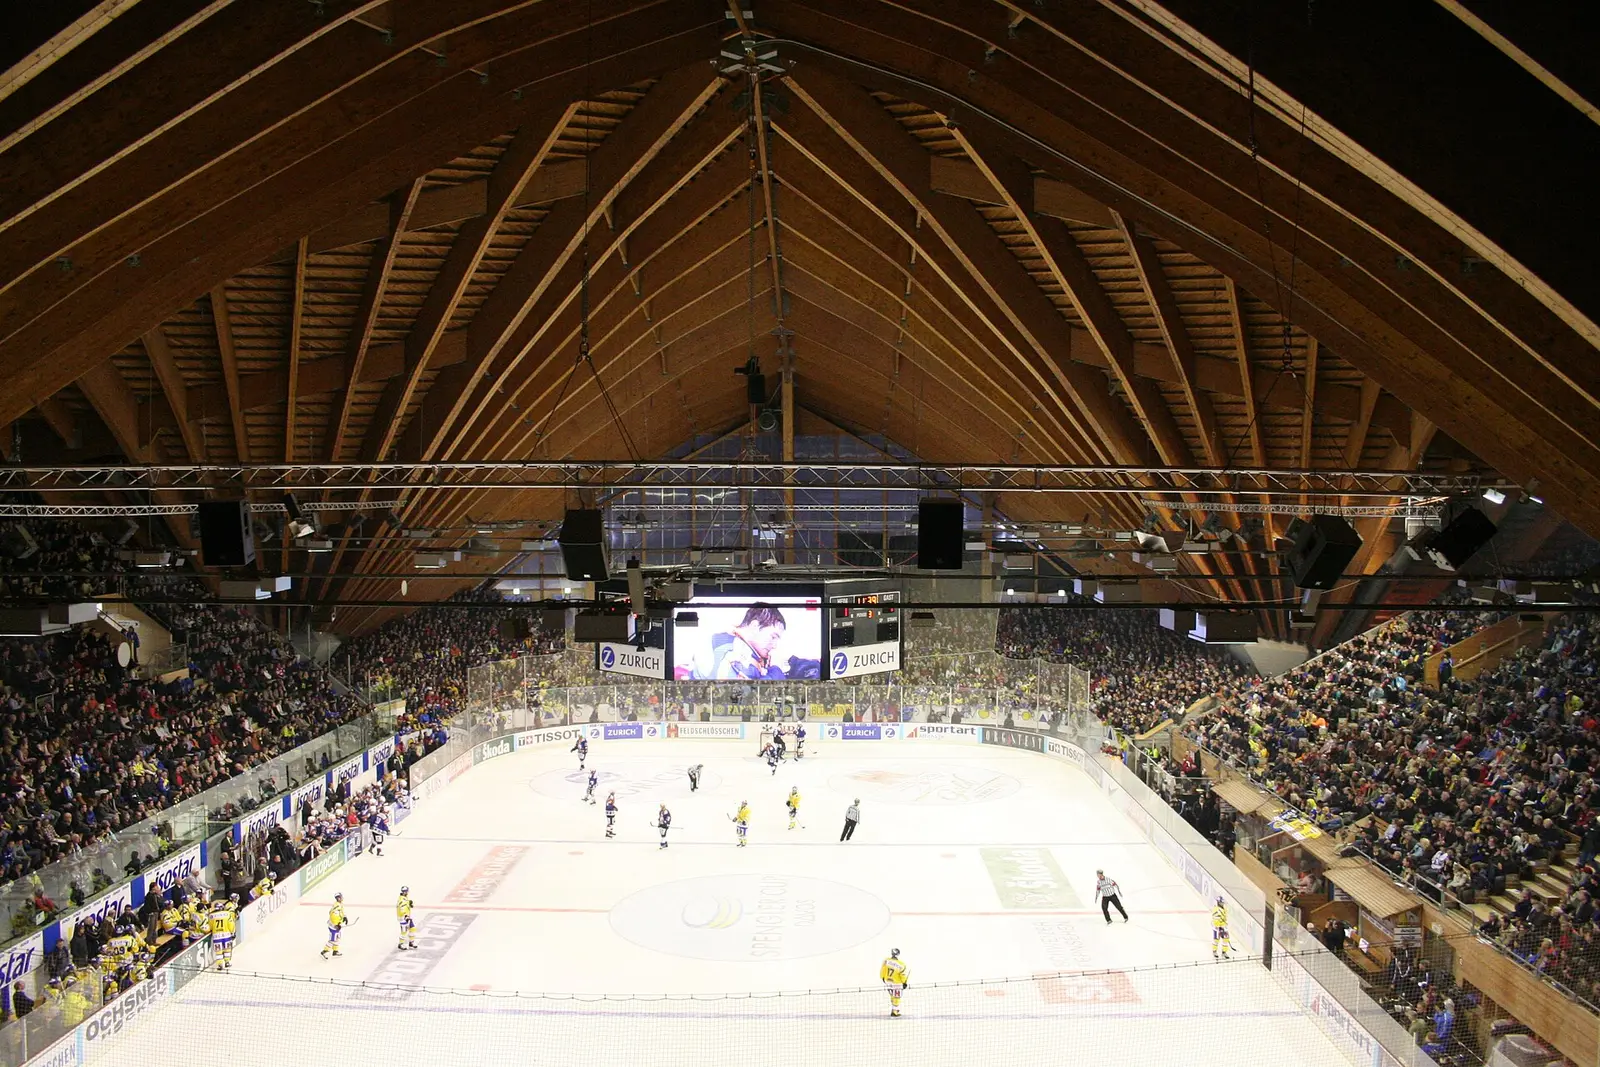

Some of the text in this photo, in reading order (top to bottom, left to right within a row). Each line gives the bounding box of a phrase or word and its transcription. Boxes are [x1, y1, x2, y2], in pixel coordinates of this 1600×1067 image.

[620, 653, 660, 670] ZURICH
[853, 650, 895, 667] ZURICH
[534, 728, 580, 744] TISSOT
[607, 728, 636, 737] ZURICH
[679, 726, 739, 736] FELDSCHLÖSSCHEN
[845, 729, 875, 737] ZURICH
[919, 724, 976, 738] sportart
[373, 744, 393, 764] isostar
[482, 739, 510, 761] Škoda
[337, 761, 361, 781] isostar
[296, 782, 323, 811] isostar
[155, 855, 196, 890] isostar
[305, 848, 340, 884] Europcar
[267, 889, 288, 914] UBS
[215, 919, 224, 929] 71
[85, 971, 167, 1042] OCHSNER
[1321, 995, 1372, 1057] sportart
